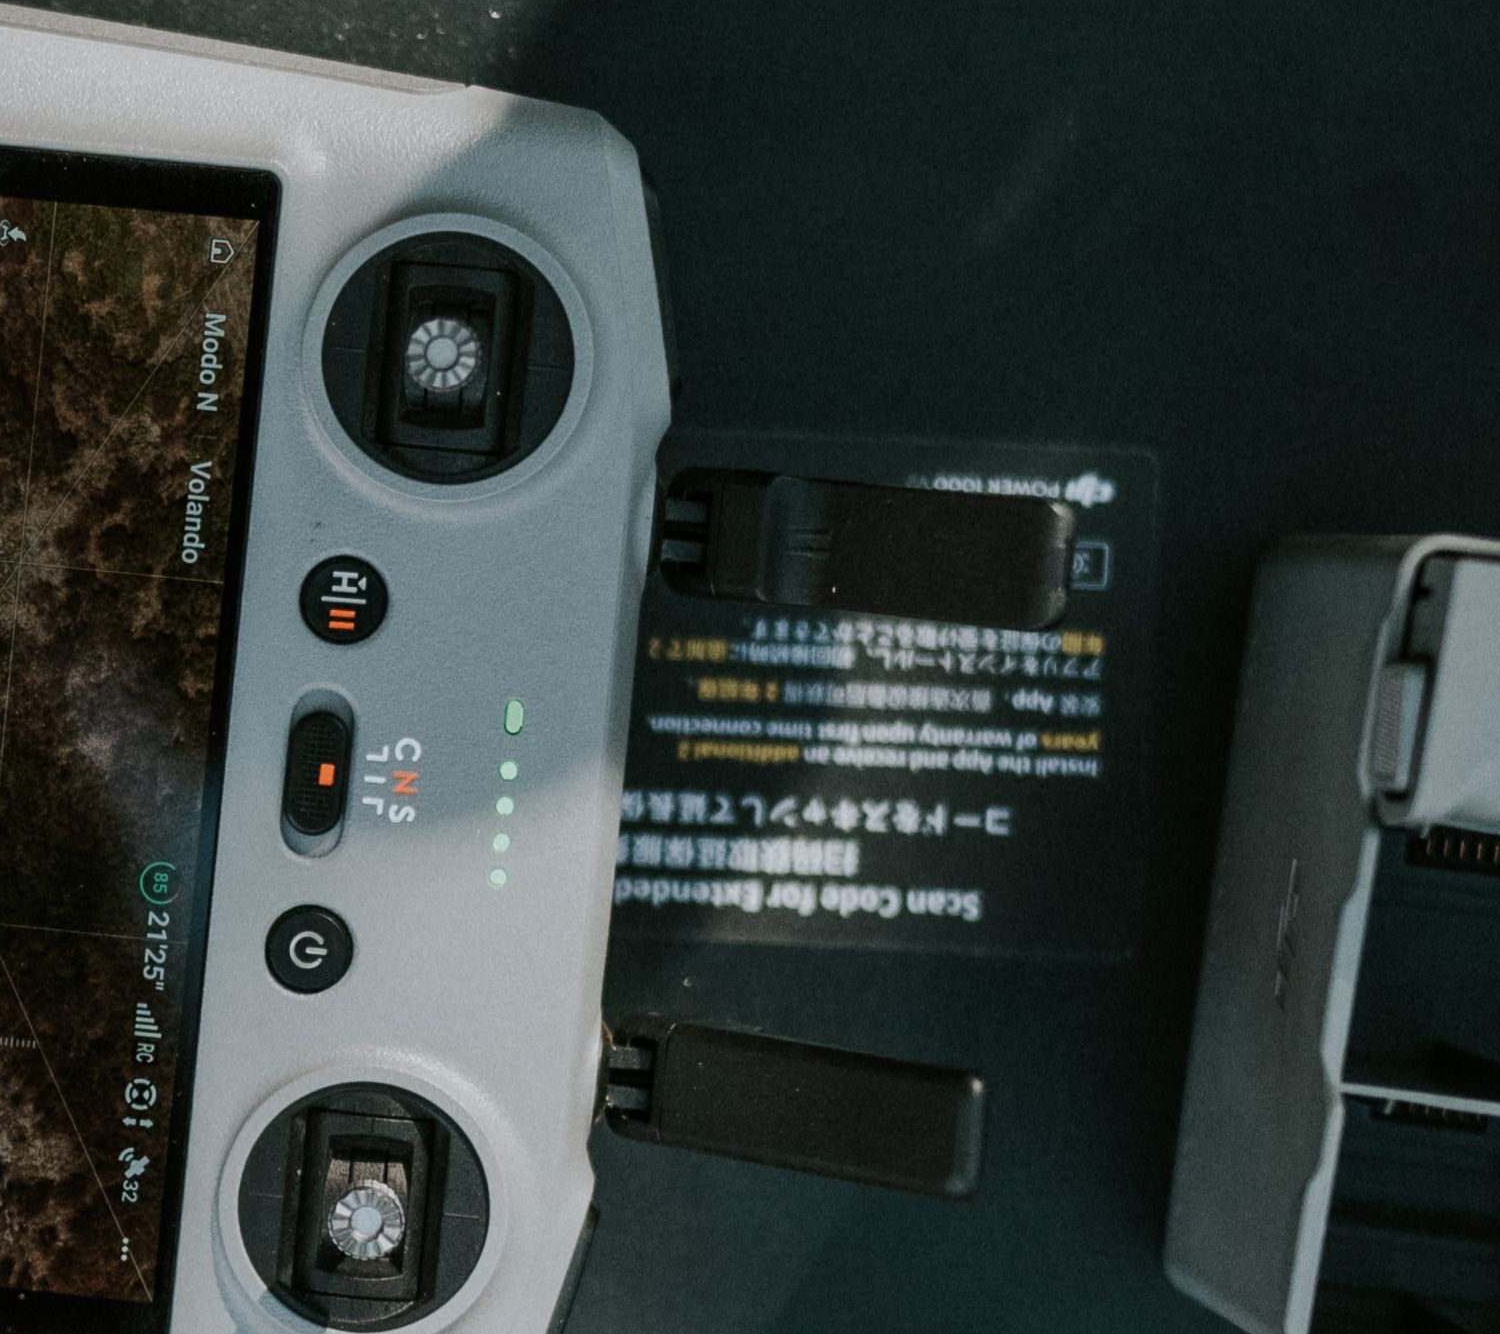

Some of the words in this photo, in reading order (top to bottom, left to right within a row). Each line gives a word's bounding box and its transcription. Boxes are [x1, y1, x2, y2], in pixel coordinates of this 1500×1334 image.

[198, 312, 227, 384] Modo
[196, 391, 218, 412] N
[932, 475, 982, 493] 1000
[987, 477, 1060, 499] POWER
[180, 460, 212, 564] Volando
[767, 721, 812, 740] time
[817, 722, 860, 742] first
[861, 721, 916, 744] upon
[919, 722, 1013, 749] warranty
[1041, 731, 1101, 751] years
[394, 737, 422, 762] C
[1015, 732, 1038, 752] of
[694, 742, 801, 765] additional
[803, 746, 830, 764] an
[832, 746, 907, 770] receive
[908, 750, 950, 772] and
[952, 750, 994, 774] App
[997, 755, 1031, 776] the
[1035, 758, 1099, 778] Install
[391, 771, 418, 796] N
[388, 804, 415, 823] S
[152, 872, 169, 894] 85
[614, 876, 764, 914] Extended
[766, 881, 817, 917] for
[820, 883, 902, 919] Code
[906, 890, 982, 923] Scan
[135, 1043, 154, 1063] RC
[120, 1179, 139, 1203] 32
